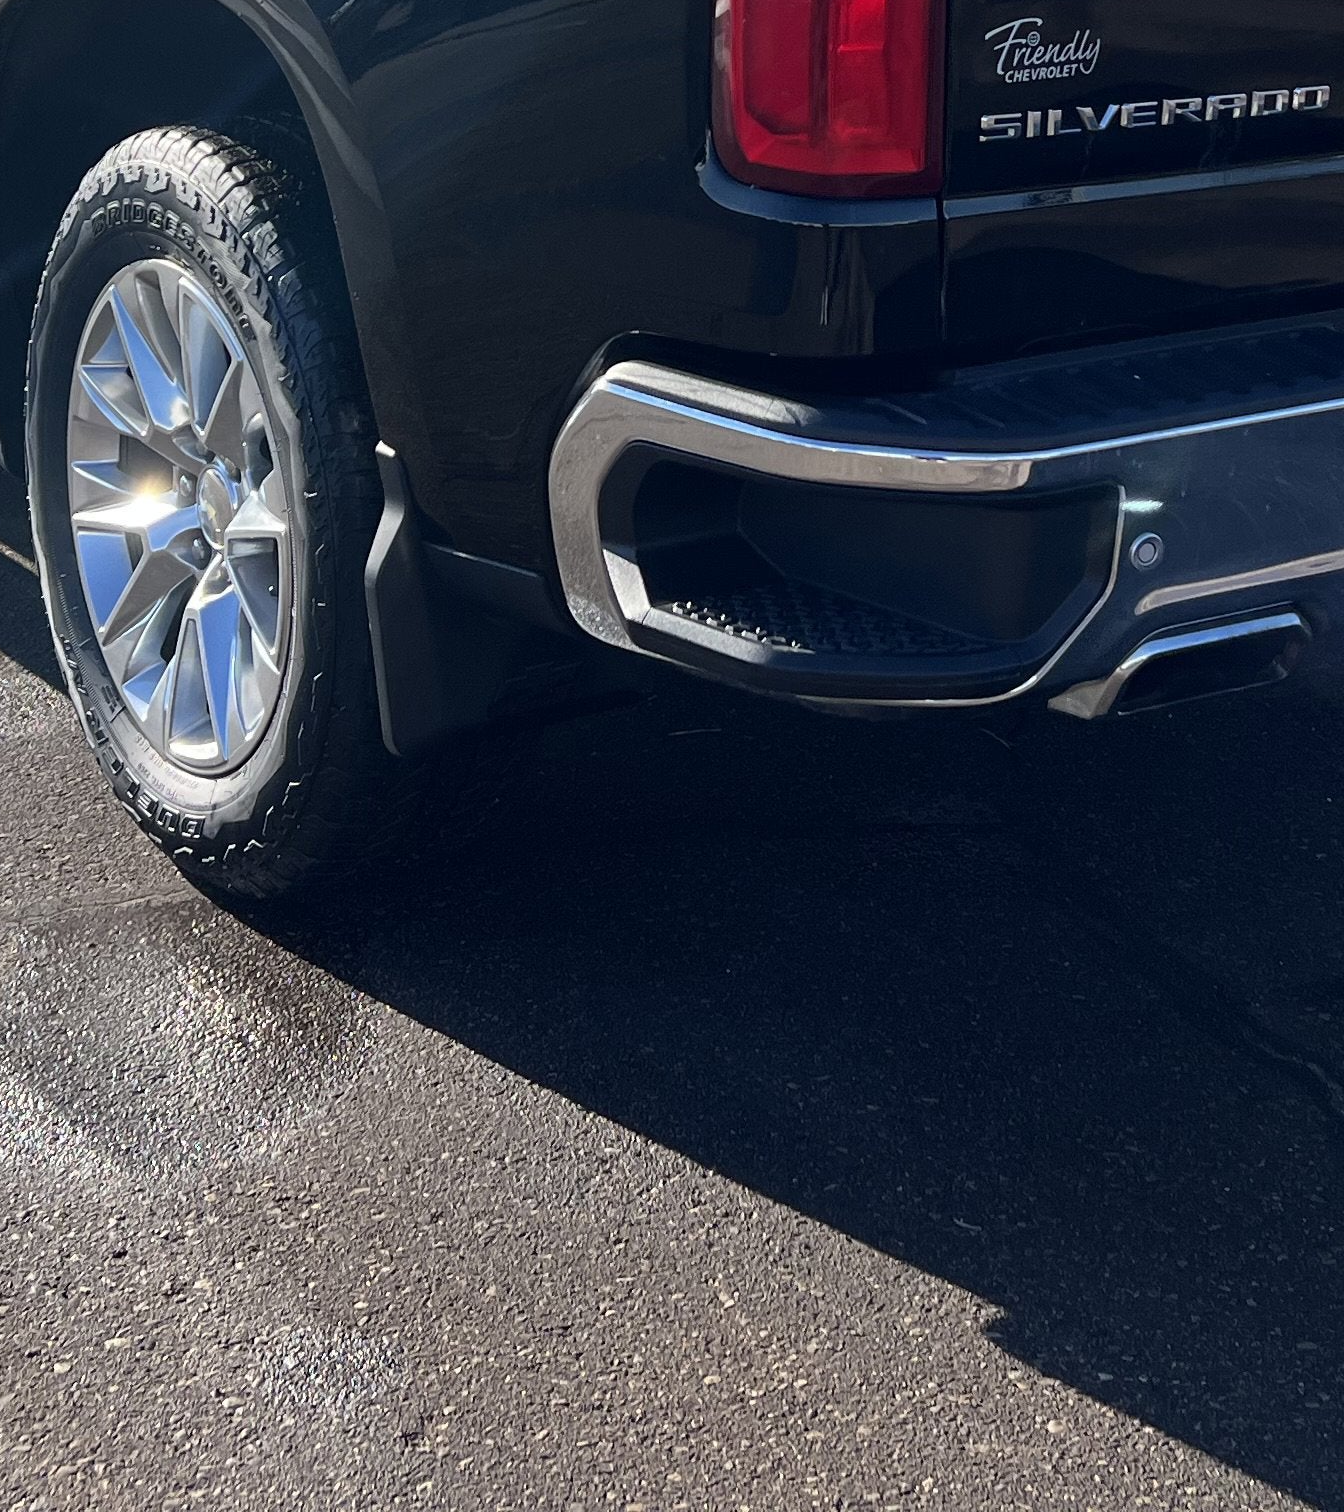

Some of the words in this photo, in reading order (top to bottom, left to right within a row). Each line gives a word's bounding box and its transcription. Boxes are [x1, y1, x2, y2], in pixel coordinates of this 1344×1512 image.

[984, 17, 1102, 75] Friendly
[1005, 64, 1079, 84] CHEVROLET
[979, 85, 1331, 142] SILVERADO
[90, 197, 257, 343] BRIDGESTONE
